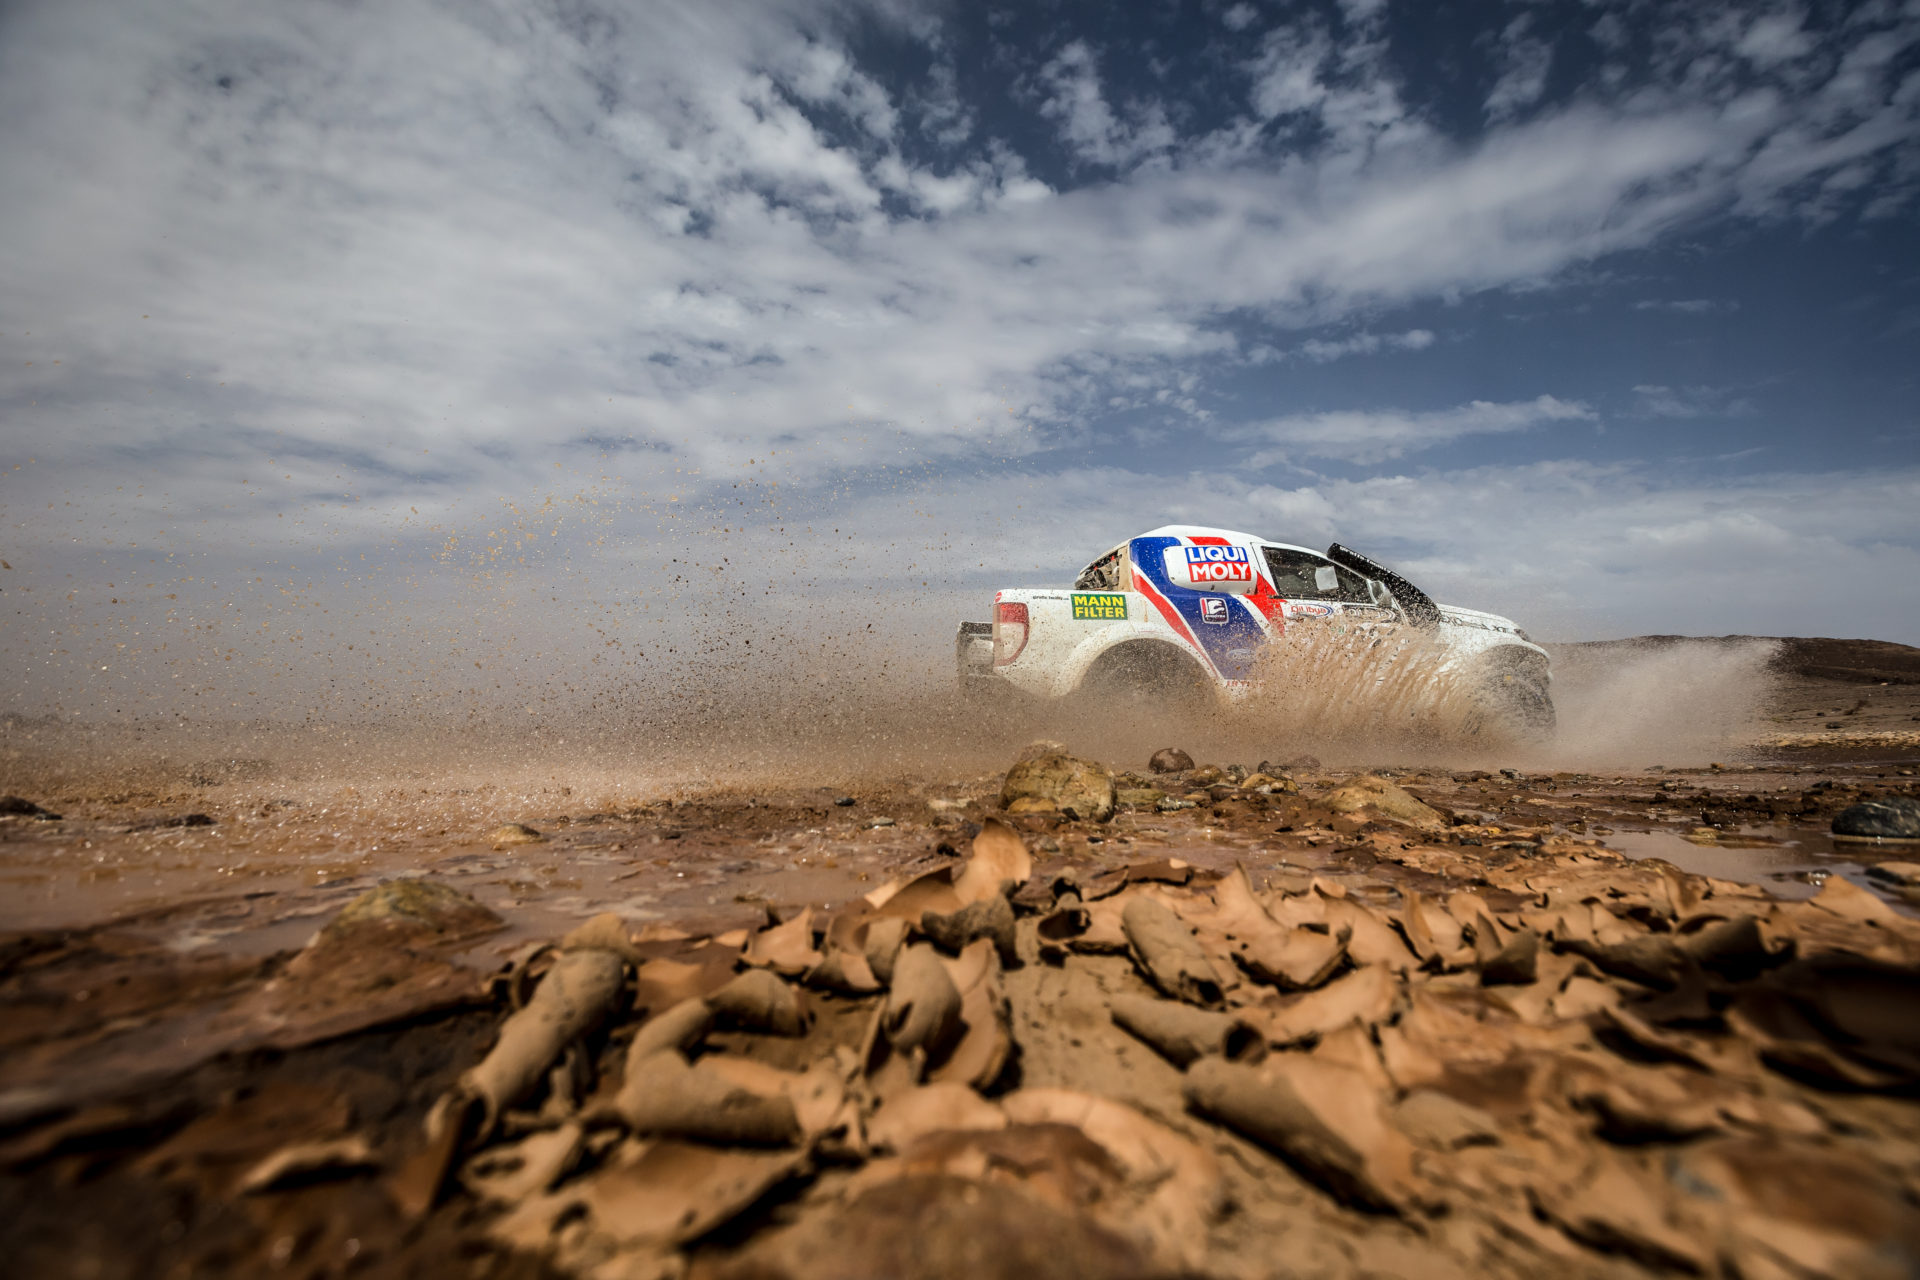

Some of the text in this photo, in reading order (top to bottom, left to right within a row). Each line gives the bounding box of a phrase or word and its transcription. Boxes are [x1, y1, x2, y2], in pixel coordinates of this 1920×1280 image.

[1187, 547, 1246, 562] LIQUI
[1191, 563, 1248, 580] MOLY
[1074, 596, 1124, 606] MANN
[1075, 607, 1125, 618] FILTER
